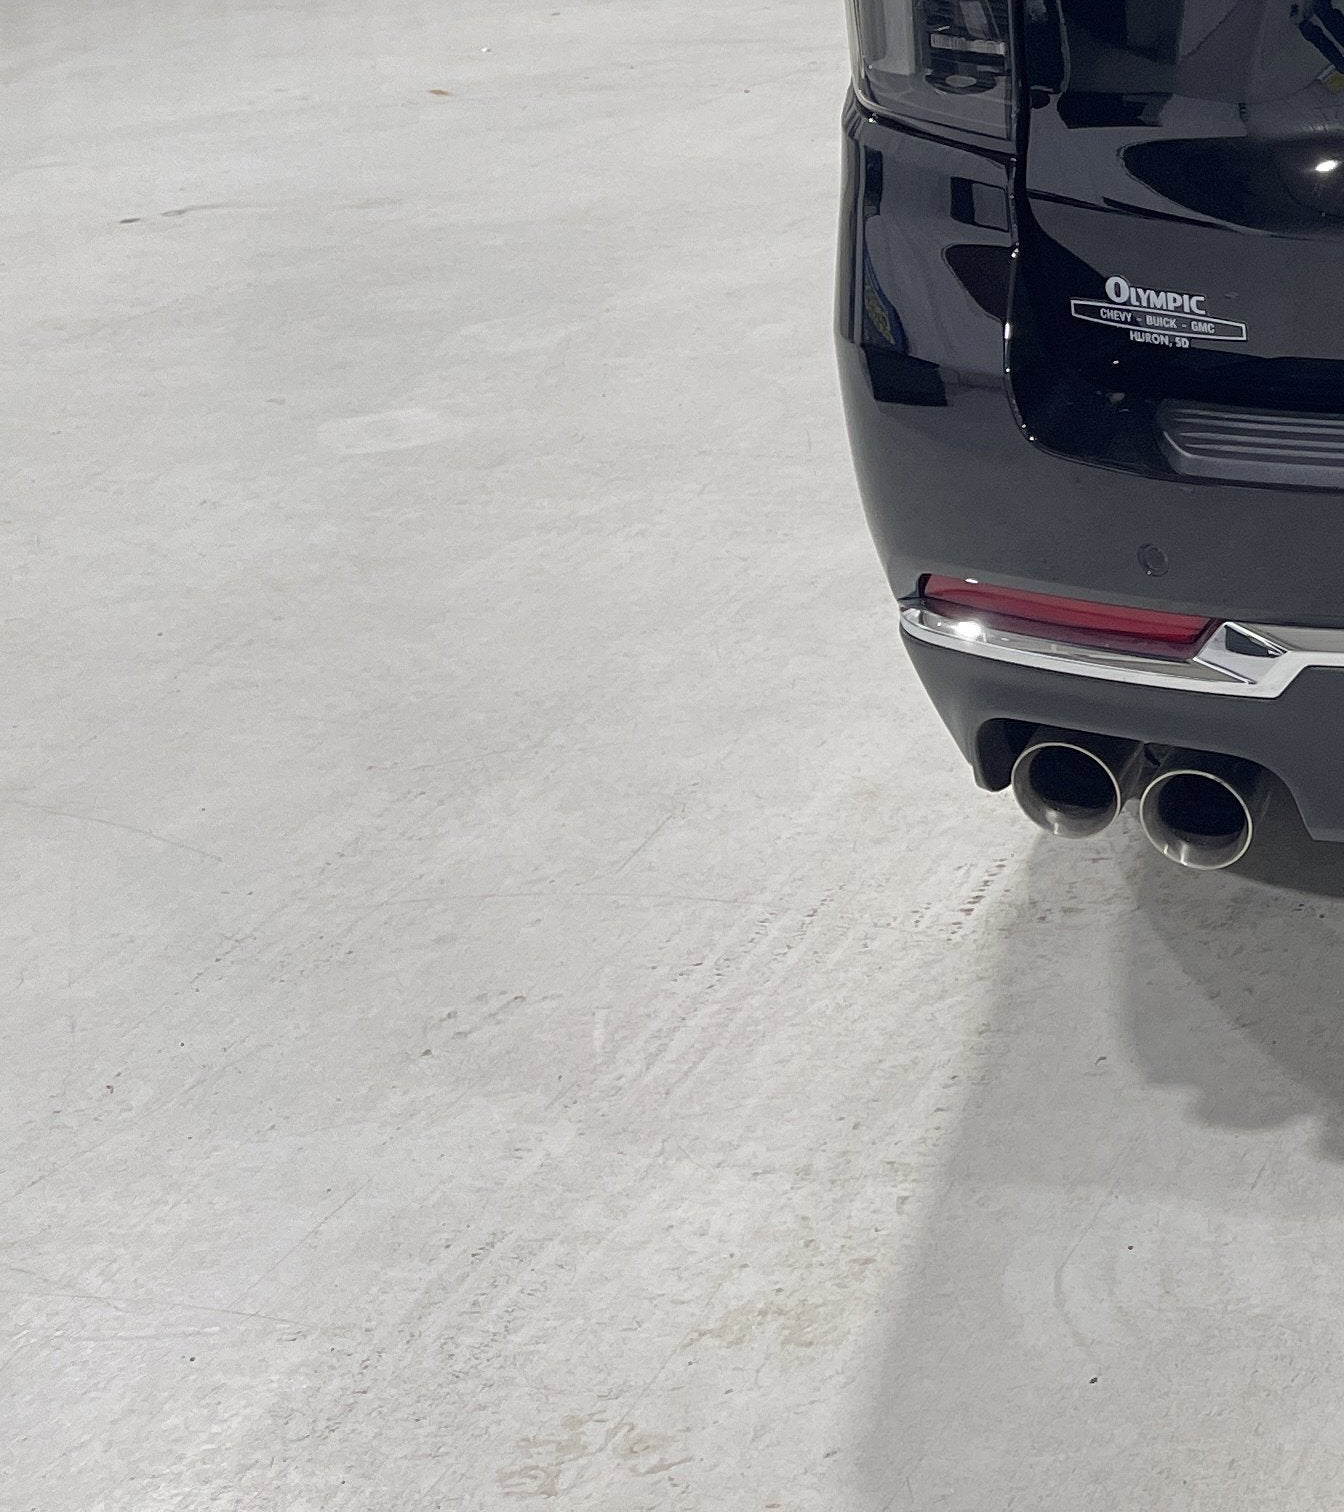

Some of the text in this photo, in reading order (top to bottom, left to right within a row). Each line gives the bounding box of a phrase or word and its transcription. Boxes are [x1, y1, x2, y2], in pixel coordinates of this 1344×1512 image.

[1104, 276, 1207, 315] OLYMPIC
[1100, 308, 1133, 323] CHEVY
[1146, 315, 1178, 329] BUICK
[1191, 321, 1215, 334] GMC
[1129, 330, 1190, 349] HURON, SD
